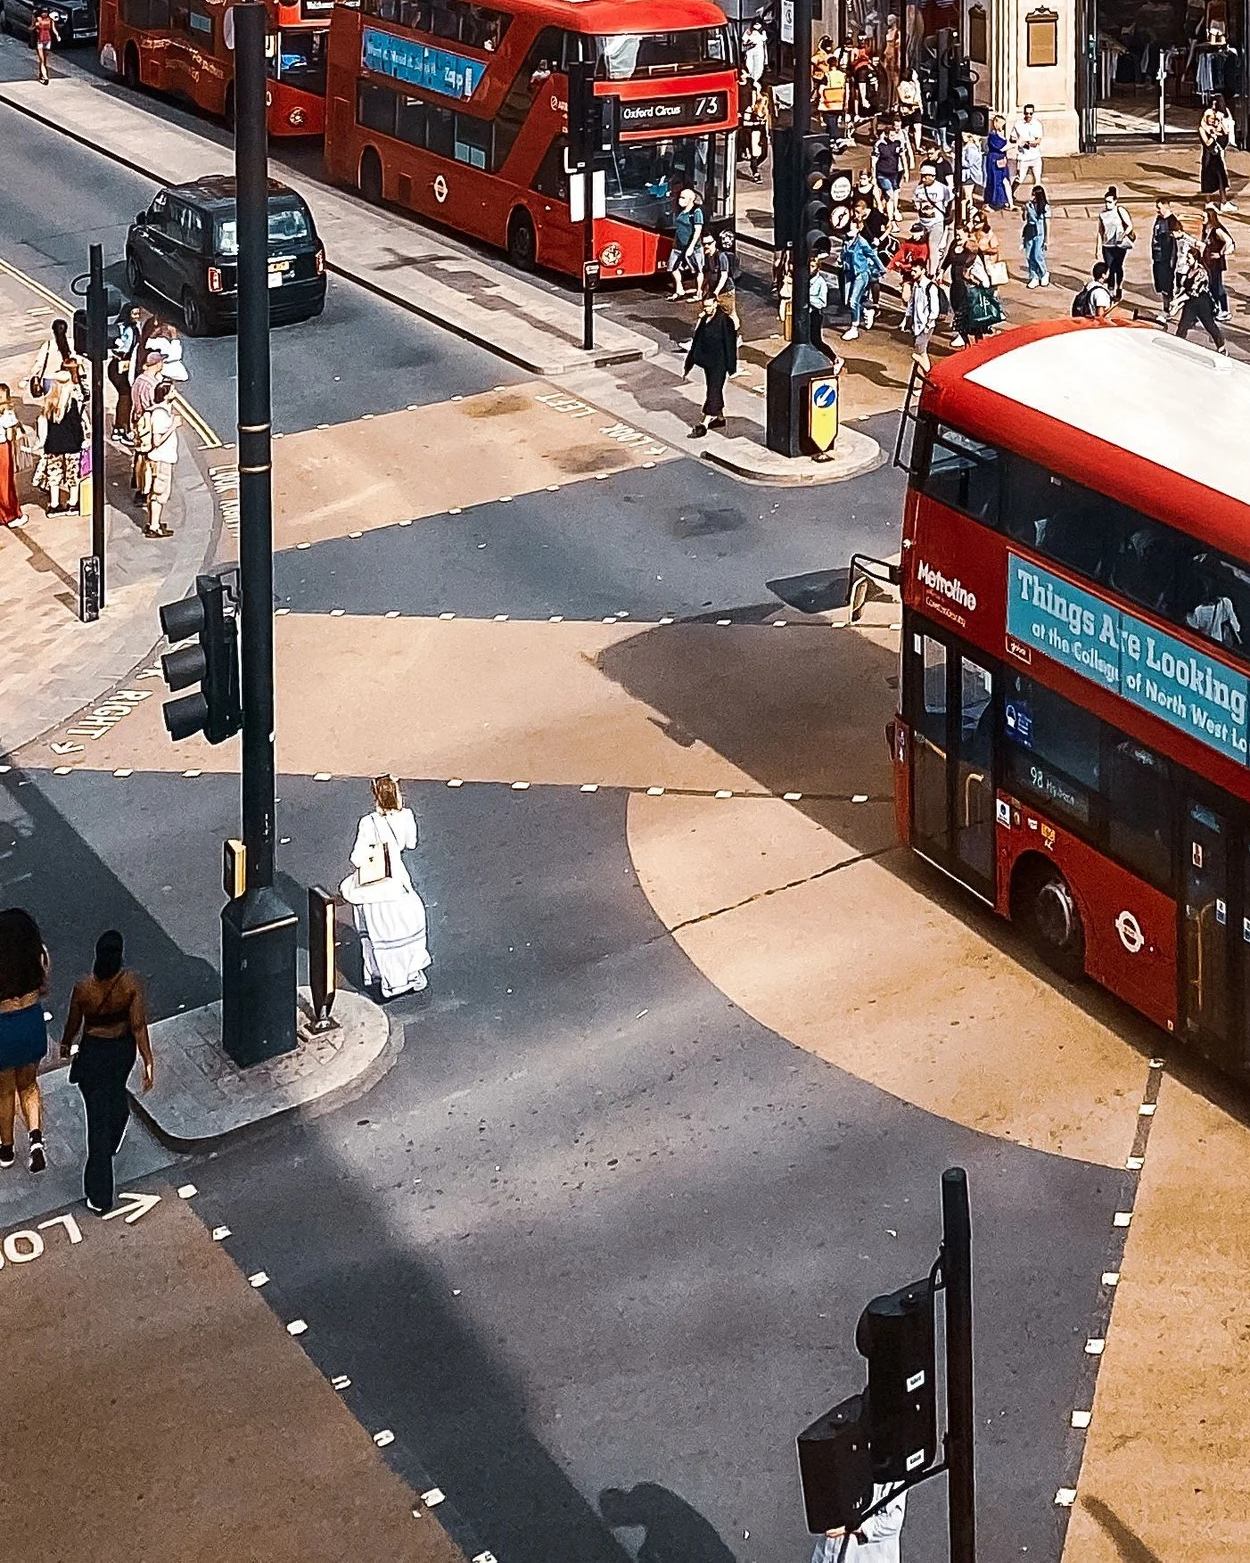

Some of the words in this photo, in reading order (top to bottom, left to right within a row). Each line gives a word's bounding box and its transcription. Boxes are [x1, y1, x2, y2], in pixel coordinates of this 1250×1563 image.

[623, 106, 654, 120] Oxford
[655, 104, 681, 117] Circus
[695, 96, 718, 116] 73
[916, 559, 977, 612] Metroline
[1016, 568, 1096, 637] Things
[1099, 612, 1141, 661] Are
[1146, 637, 1248, 727] Looking
[1031, 622, 1047, 639] at
[1048, 626, 1070, 655] the
[1126, 672, 1144, 694] of
[1145, 678, 1188, 720] North
[1190, 703, 1229, 740] West
[67, 688, 154, 741] RIGHT
[1030, 766, 1045, 789] 98
[0, 1212, 83, 1270] LO
